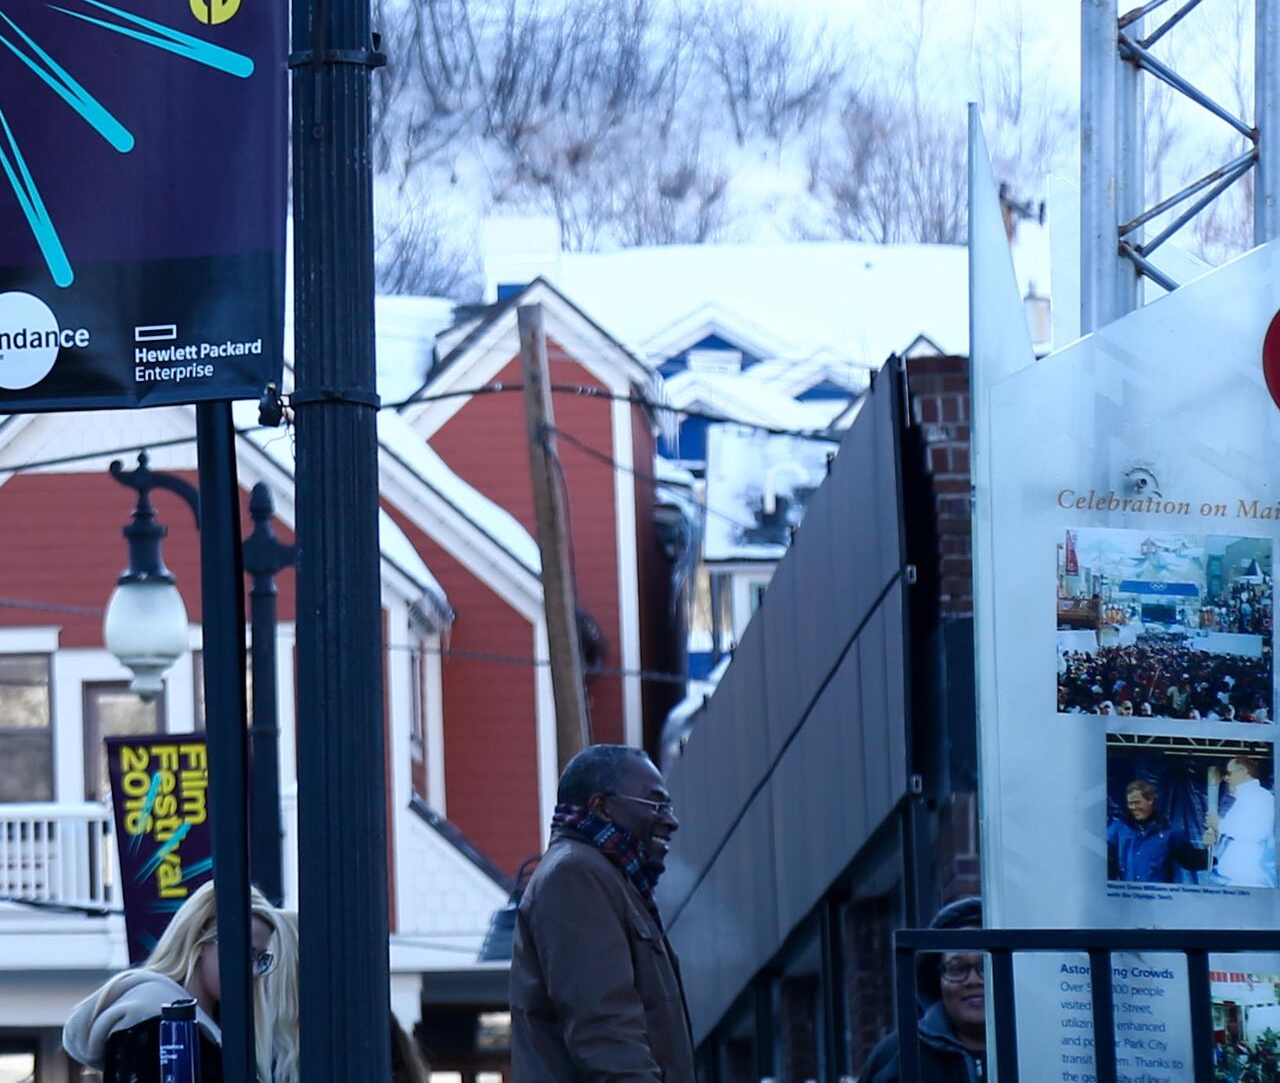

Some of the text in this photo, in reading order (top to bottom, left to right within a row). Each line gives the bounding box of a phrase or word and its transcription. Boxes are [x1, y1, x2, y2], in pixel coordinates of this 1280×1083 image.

[135, 339, 262, 364] Hewlett Packard
[135, 363, 214, 382] Enterprise
[1057, 489, 1190, 515] Celebration
[1200, 502, 1227, 517] on
[1131, 967, 1175, 980] Crowds
[1060, 981, 1083, 992] Over
[1131, 986, 1166, 998] people
[1061, 1018, 1166, 1033] utilizin enhanced
[1062, 1036, 1081, 1046] and
[1124, 1038, 1145, 1049] Park
[1148, 1039, 1168, 1054] City
[1135, 1057, 1170, 1069] Thanks
[1172, 1060, 1184, 1070] to
